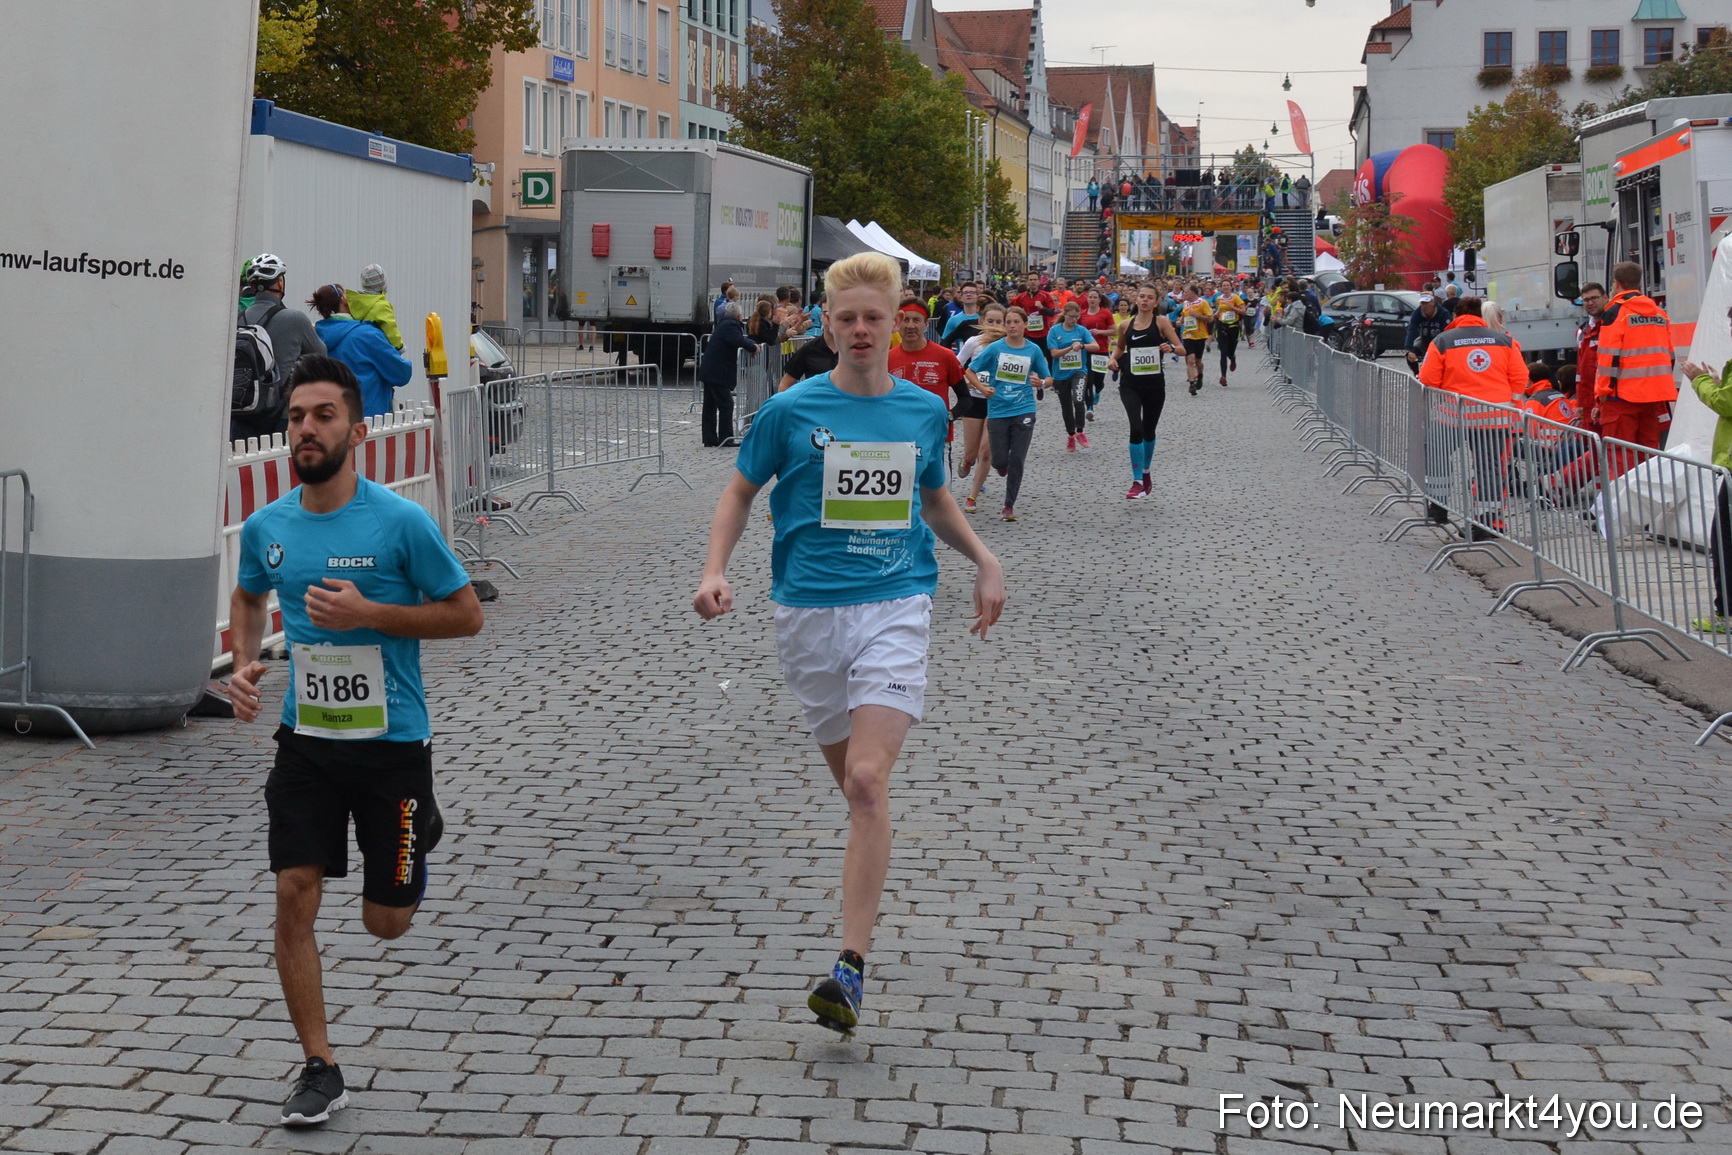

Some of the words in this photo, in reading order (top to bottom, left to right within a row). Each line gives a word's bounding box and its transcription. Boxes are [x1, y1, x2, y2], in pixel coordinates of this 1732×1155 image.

[527, 177, 549, 200] D
[1586, 169, 1608, 200] BOCK
[778, 206, 802, 242] BOCK
[1174, 217, 1205, 228] ZIEL
[1454, 338, 1496, 346] BEREITSCHAFTEN
[1135, 356, 1154, 364] 5001
[1002, 362, 1023, 373] 5091
[1076, 378, 1085, 402] adidas
[837, 470, 902, 495] 5239
[846, 545, 891, 557] Stadtlauf
[328, 557, 374, 567] BOCK
[320, 655, 351, 663] BOCK
[306, 672, 369, 702] 5186
[887, 682, 907, 692] JAKO
[322, 712, 353, 722] Hamza
